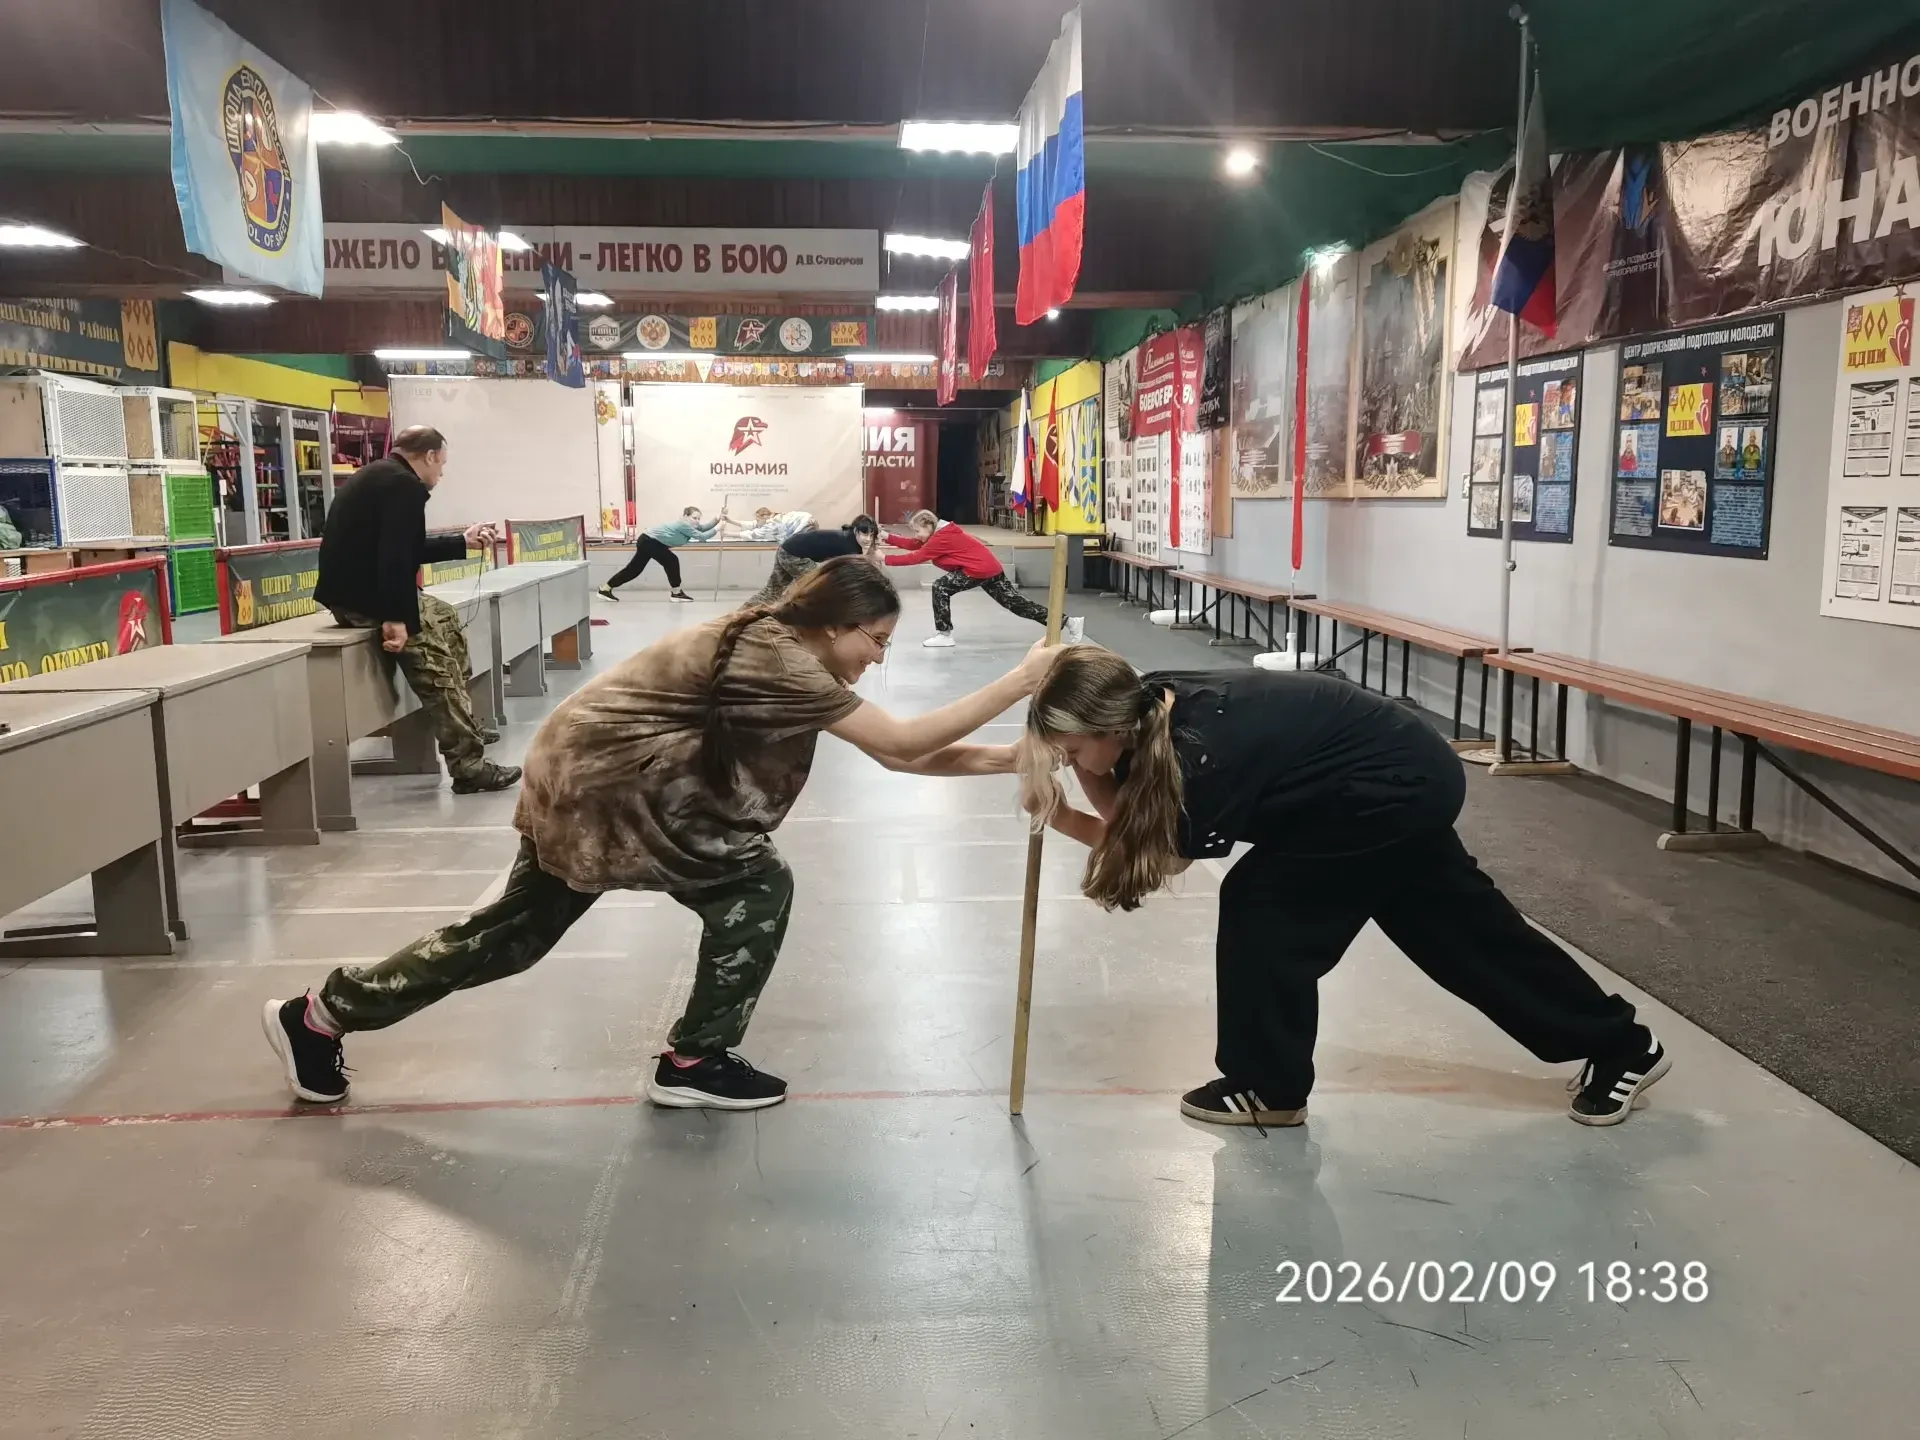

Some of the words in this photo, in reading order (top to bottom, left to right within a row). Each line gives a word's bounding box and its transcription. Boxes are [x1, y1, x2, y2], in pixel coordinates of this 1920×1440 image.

[225, 84, 243, 154] ШКОЛА
[263, 232, 274, 248] OF
[597, 242, 683, 273] ЛЕГКО
[694, 244, 711, 273] В
[721, 244, 788, 274] БОЮ
[1624, 343, 1641, 360] ЦЕНТР
[1641, 334, 1686, 357] ДОПРИЗЫВНОЙ
[1686, 329, 1730, 350] ПОДГОТОВКИ
[1730, 322, 1775, 342] МОЛОДЕЖИ
[1847, 347, 1887, 369] ЦДПМ
[710, 463, 788, 475] ЮНАРМИЯ
[261, 575, 292, 597] ЦЕНТР
